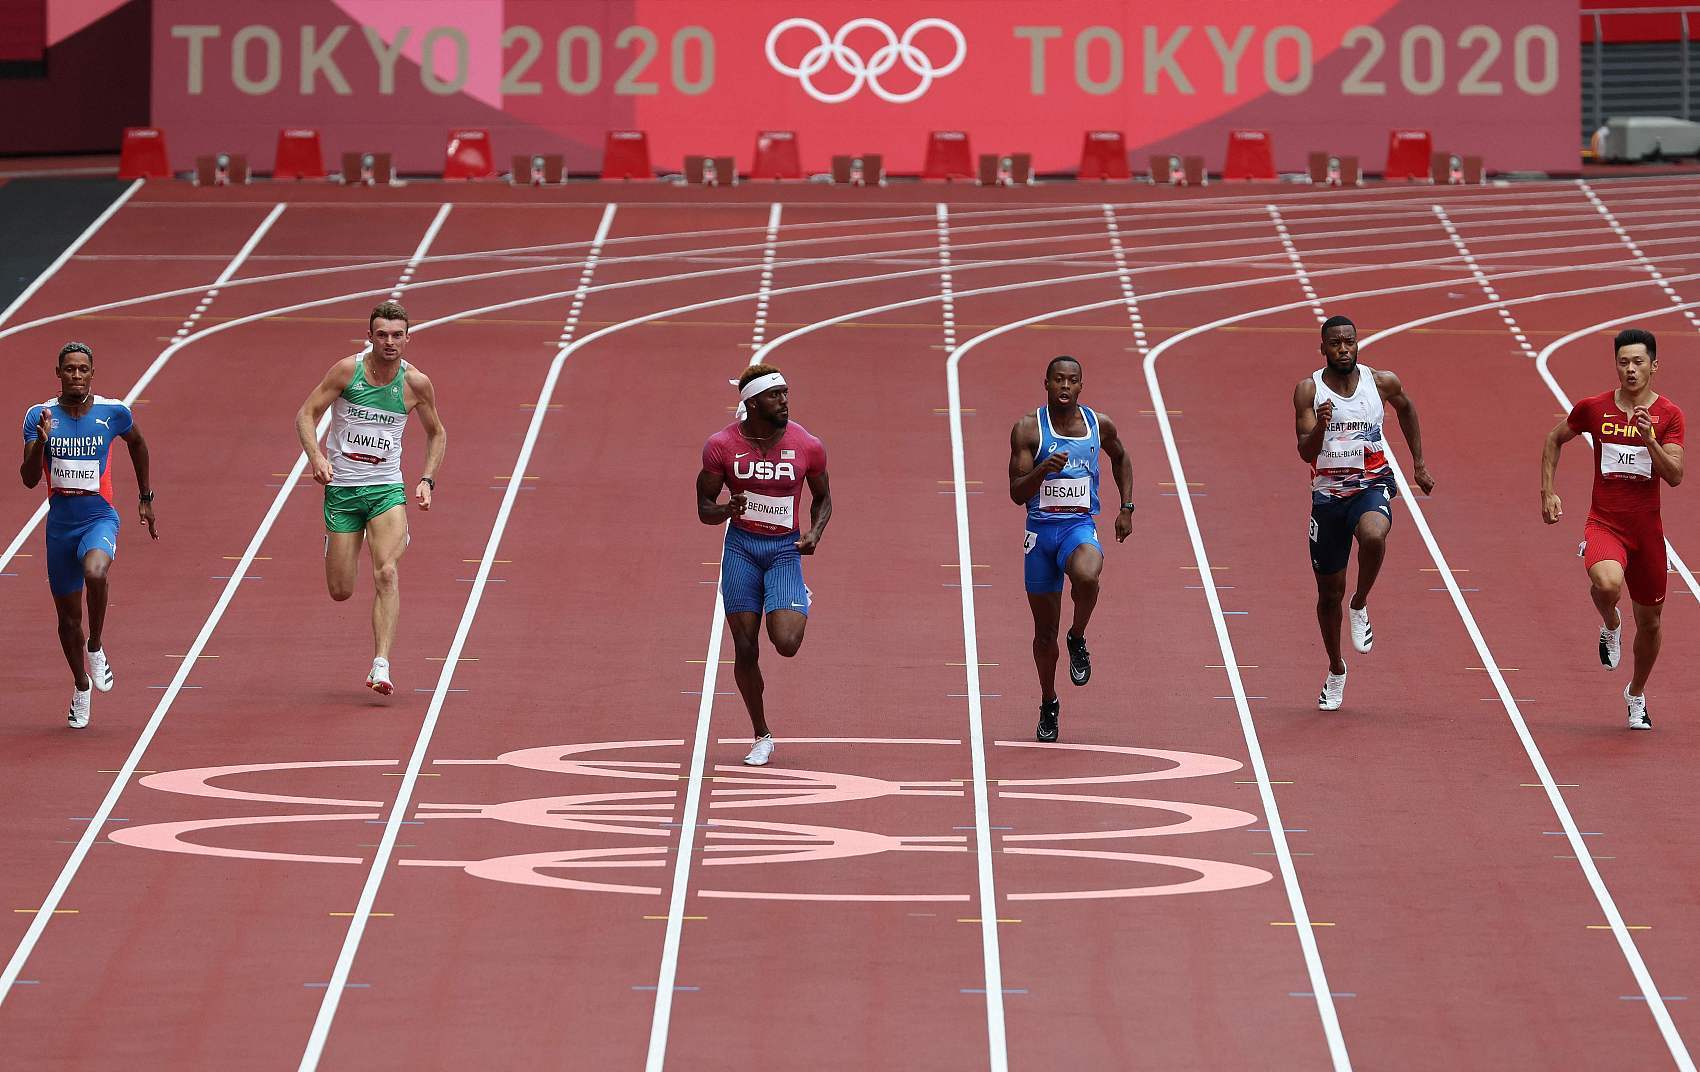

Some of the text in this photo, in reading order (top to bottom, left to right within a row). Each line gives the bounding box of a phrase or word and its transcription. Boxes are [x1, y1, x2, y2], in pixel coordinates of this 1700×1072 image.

[171, 25, 716, 95] TOKYO 2020
[1014, 25, 1559, 96] TOKYO 2020
[347, 406, 395, 425] IRELAND
[1326, 422, 1345, 432] REAT
[50, 435, 103, 447] DOMINICAN
[347, 431, 391, 451] LAWLER
[50, 447, 96, 457] REPUBLIC
[1617, 452, 1636, 465] XIE
[54, 467, 95, 480] MARTINEZ
[733, 460, 796, 481] USA
[1044, 485, 1086, 498] DESALU
[747, 501, 789, 515] BEDNAREK
